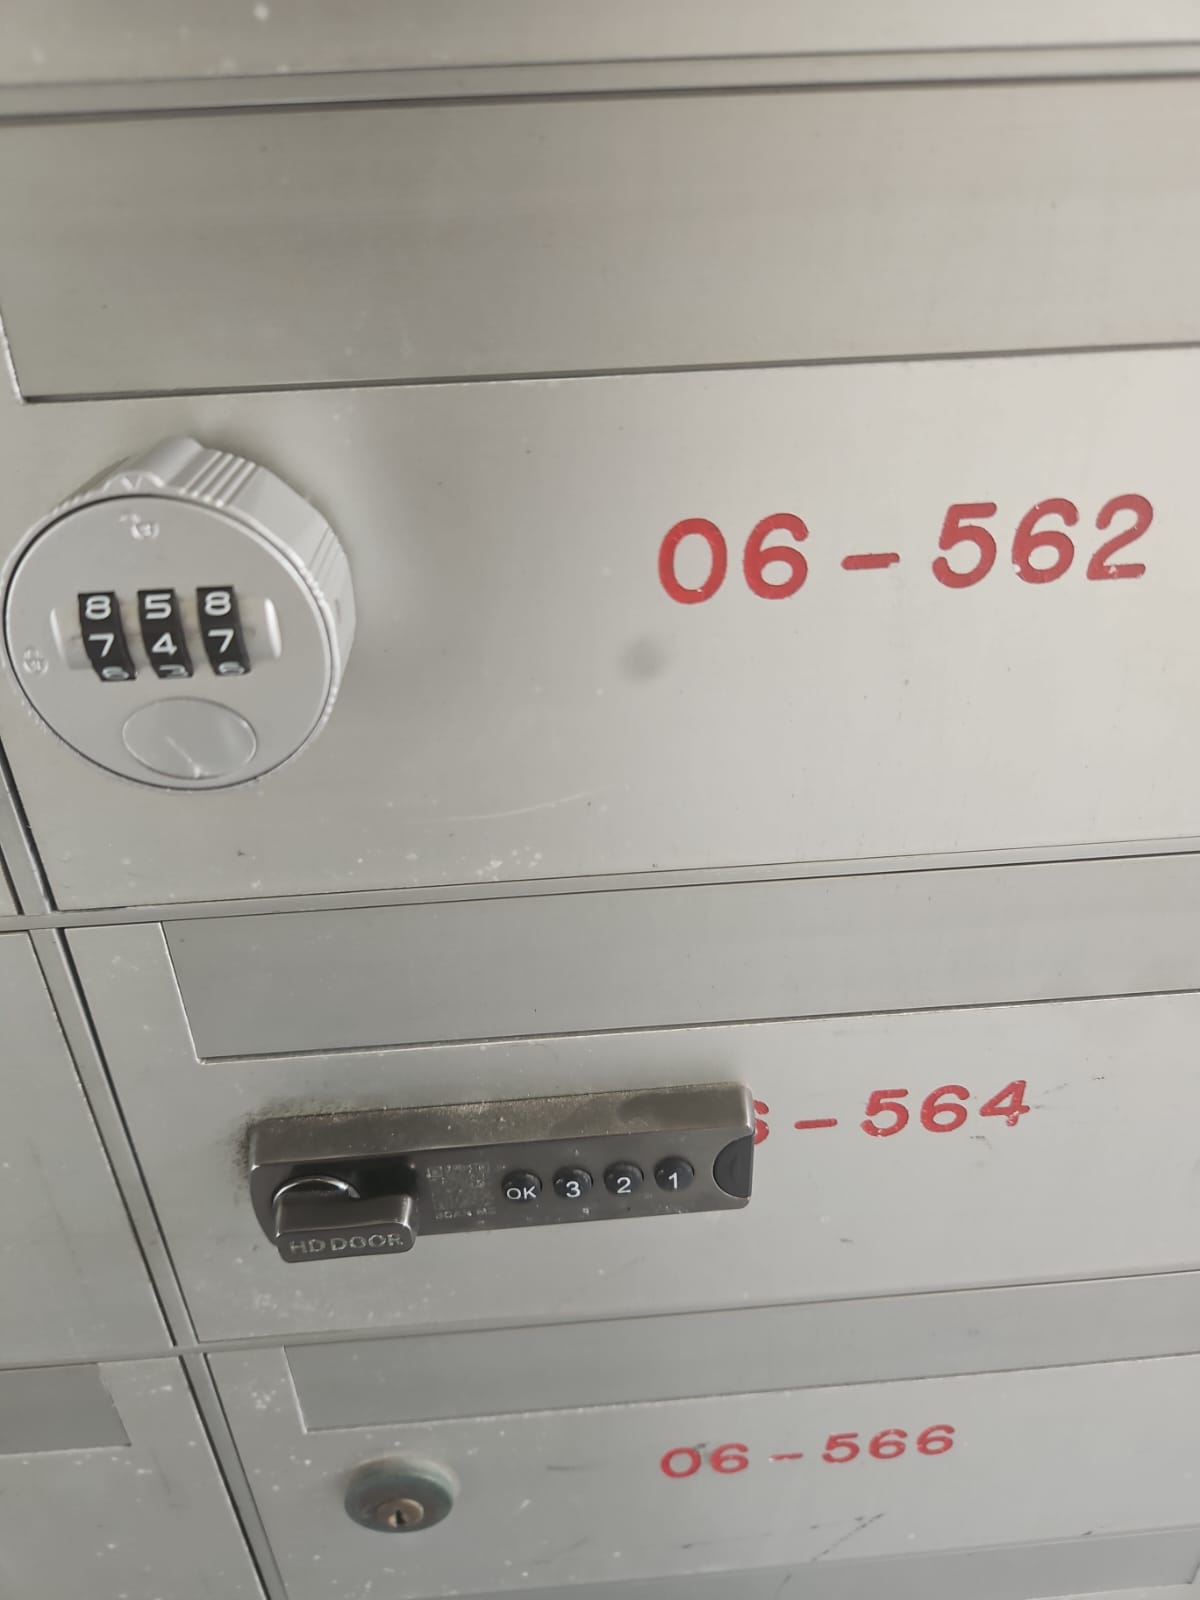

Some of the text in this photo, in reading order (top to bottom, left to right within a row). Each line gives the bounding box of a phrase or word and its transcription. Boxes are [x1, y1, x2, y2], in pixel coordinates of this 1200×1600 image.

[85, 590, 231, 620] 8 5 8
[88, 628, 234, 657] 7 4 7
[506, 1171, 678, 1200] OK 3 2 1
[289, 1233, 404, 1254] HD DOOR
